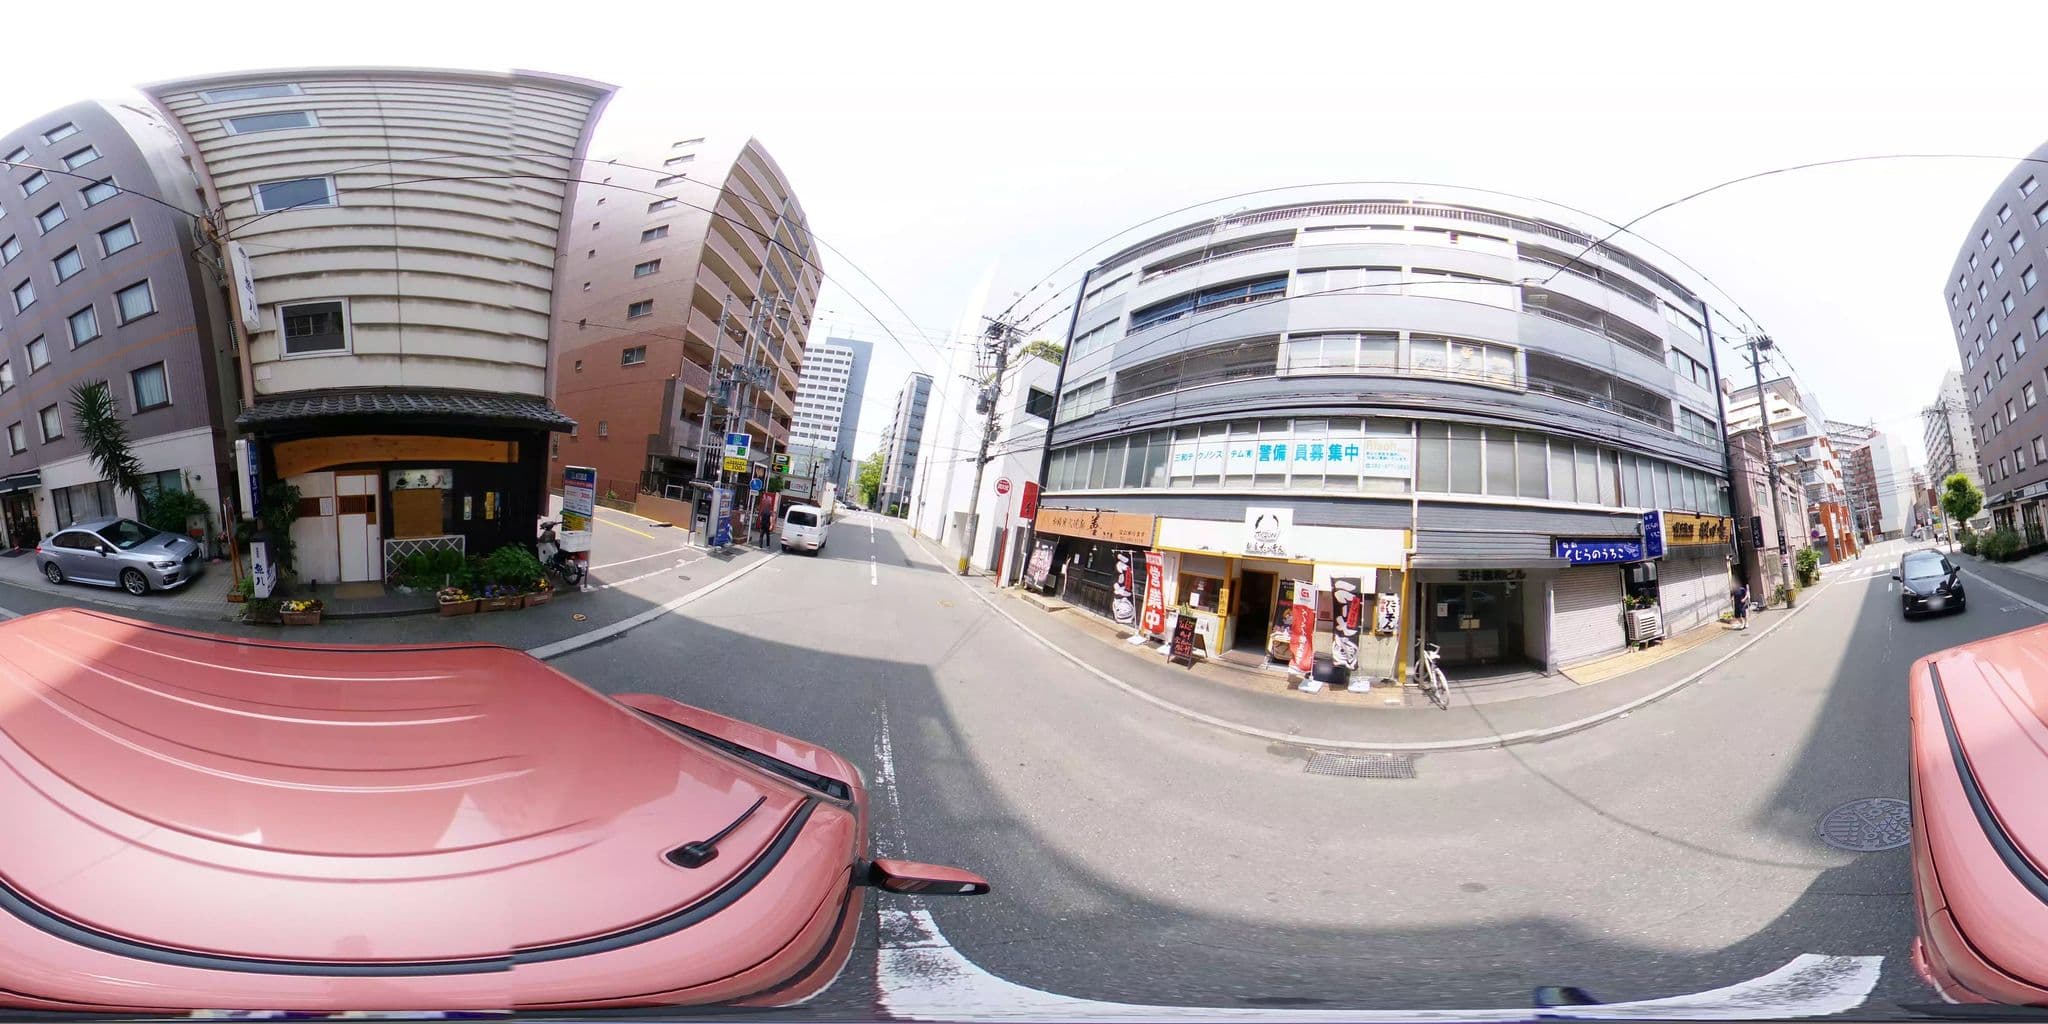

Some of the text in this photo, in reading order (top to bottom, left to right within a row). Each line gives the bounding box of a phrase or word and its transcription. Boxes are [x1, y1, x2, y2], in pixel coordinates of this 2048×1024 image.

[1259, 443, 1359, 462] 警備員募集中
[1564, 548, 1624, 561] くじらのうろこ
[1145, 565, 1162, 629] 営業中
